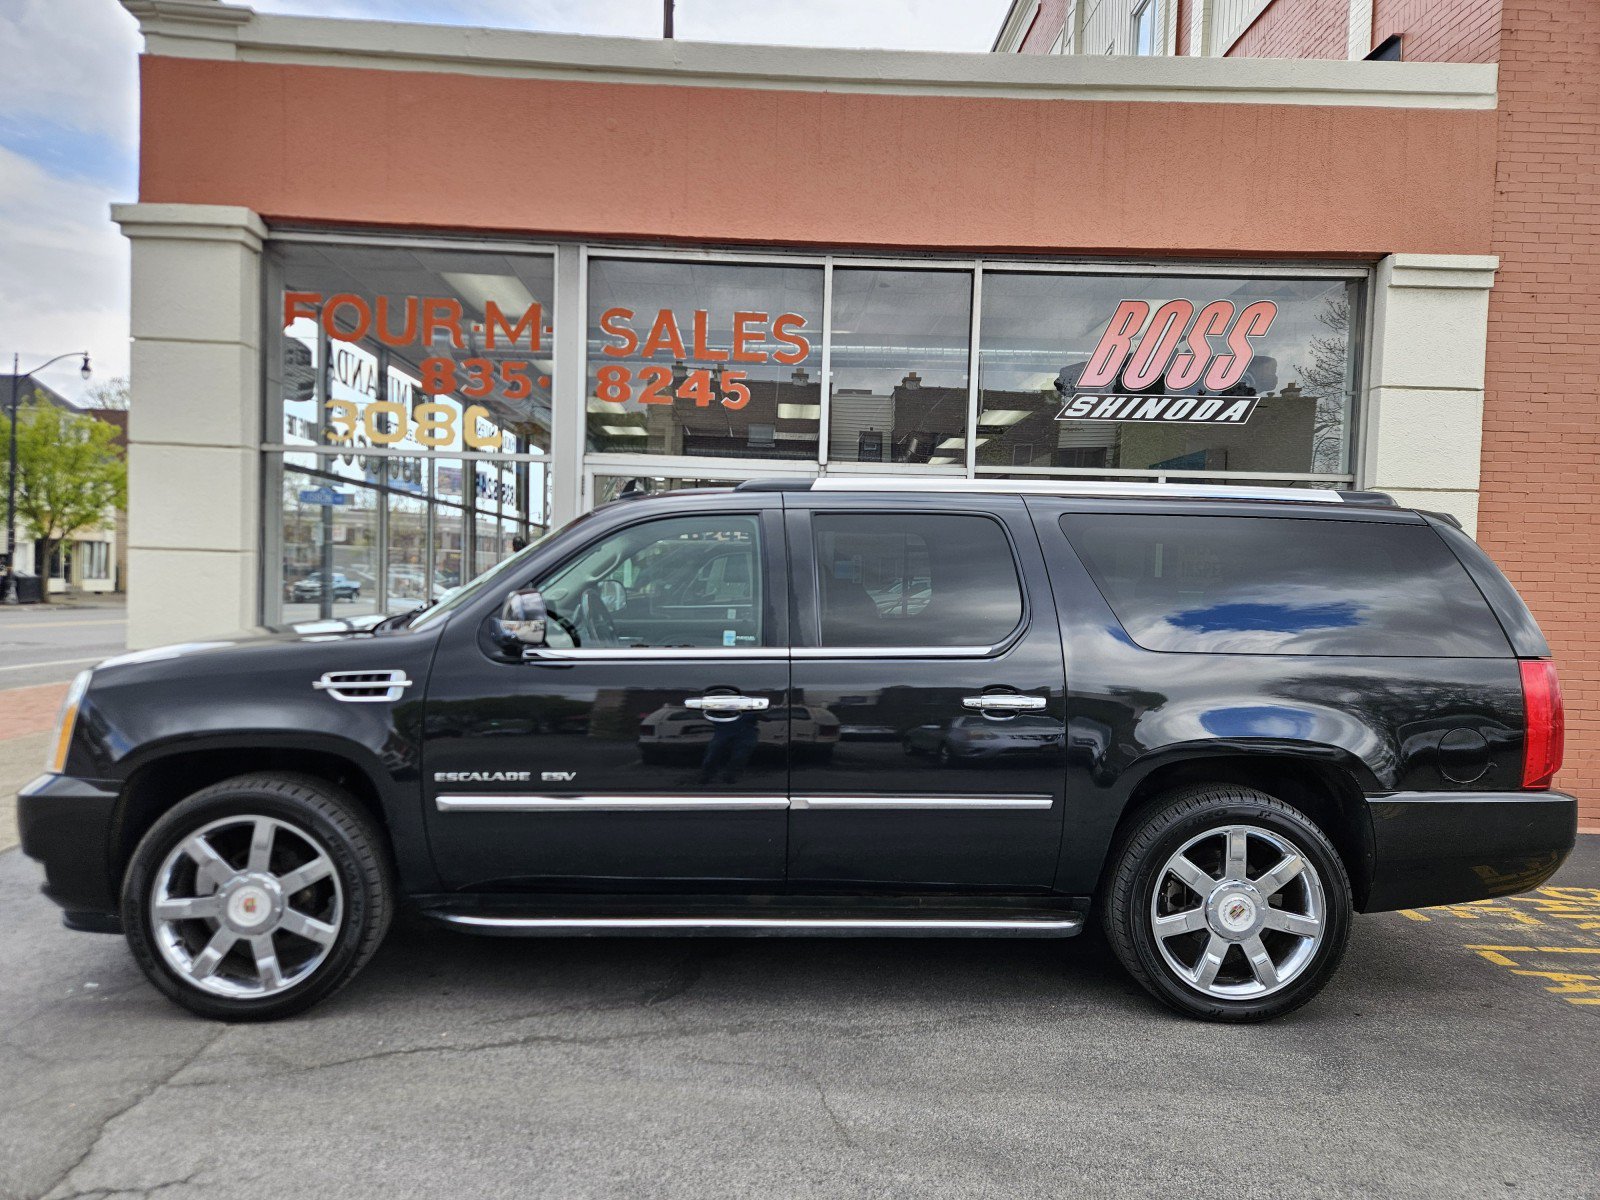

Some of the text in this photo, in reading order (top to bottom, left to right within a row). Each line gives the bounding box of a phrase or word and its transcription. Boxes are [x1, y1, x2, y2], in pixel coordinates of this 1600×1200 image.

[600, 307, 810, 365] SALES
[1075, 298, 1278, 391] BOSS
[596, 365, 751, 410] 8245
[1064, 396, 1252, 422] SHINODA
[433, 771, 577, 783] ESCALADE ESV
